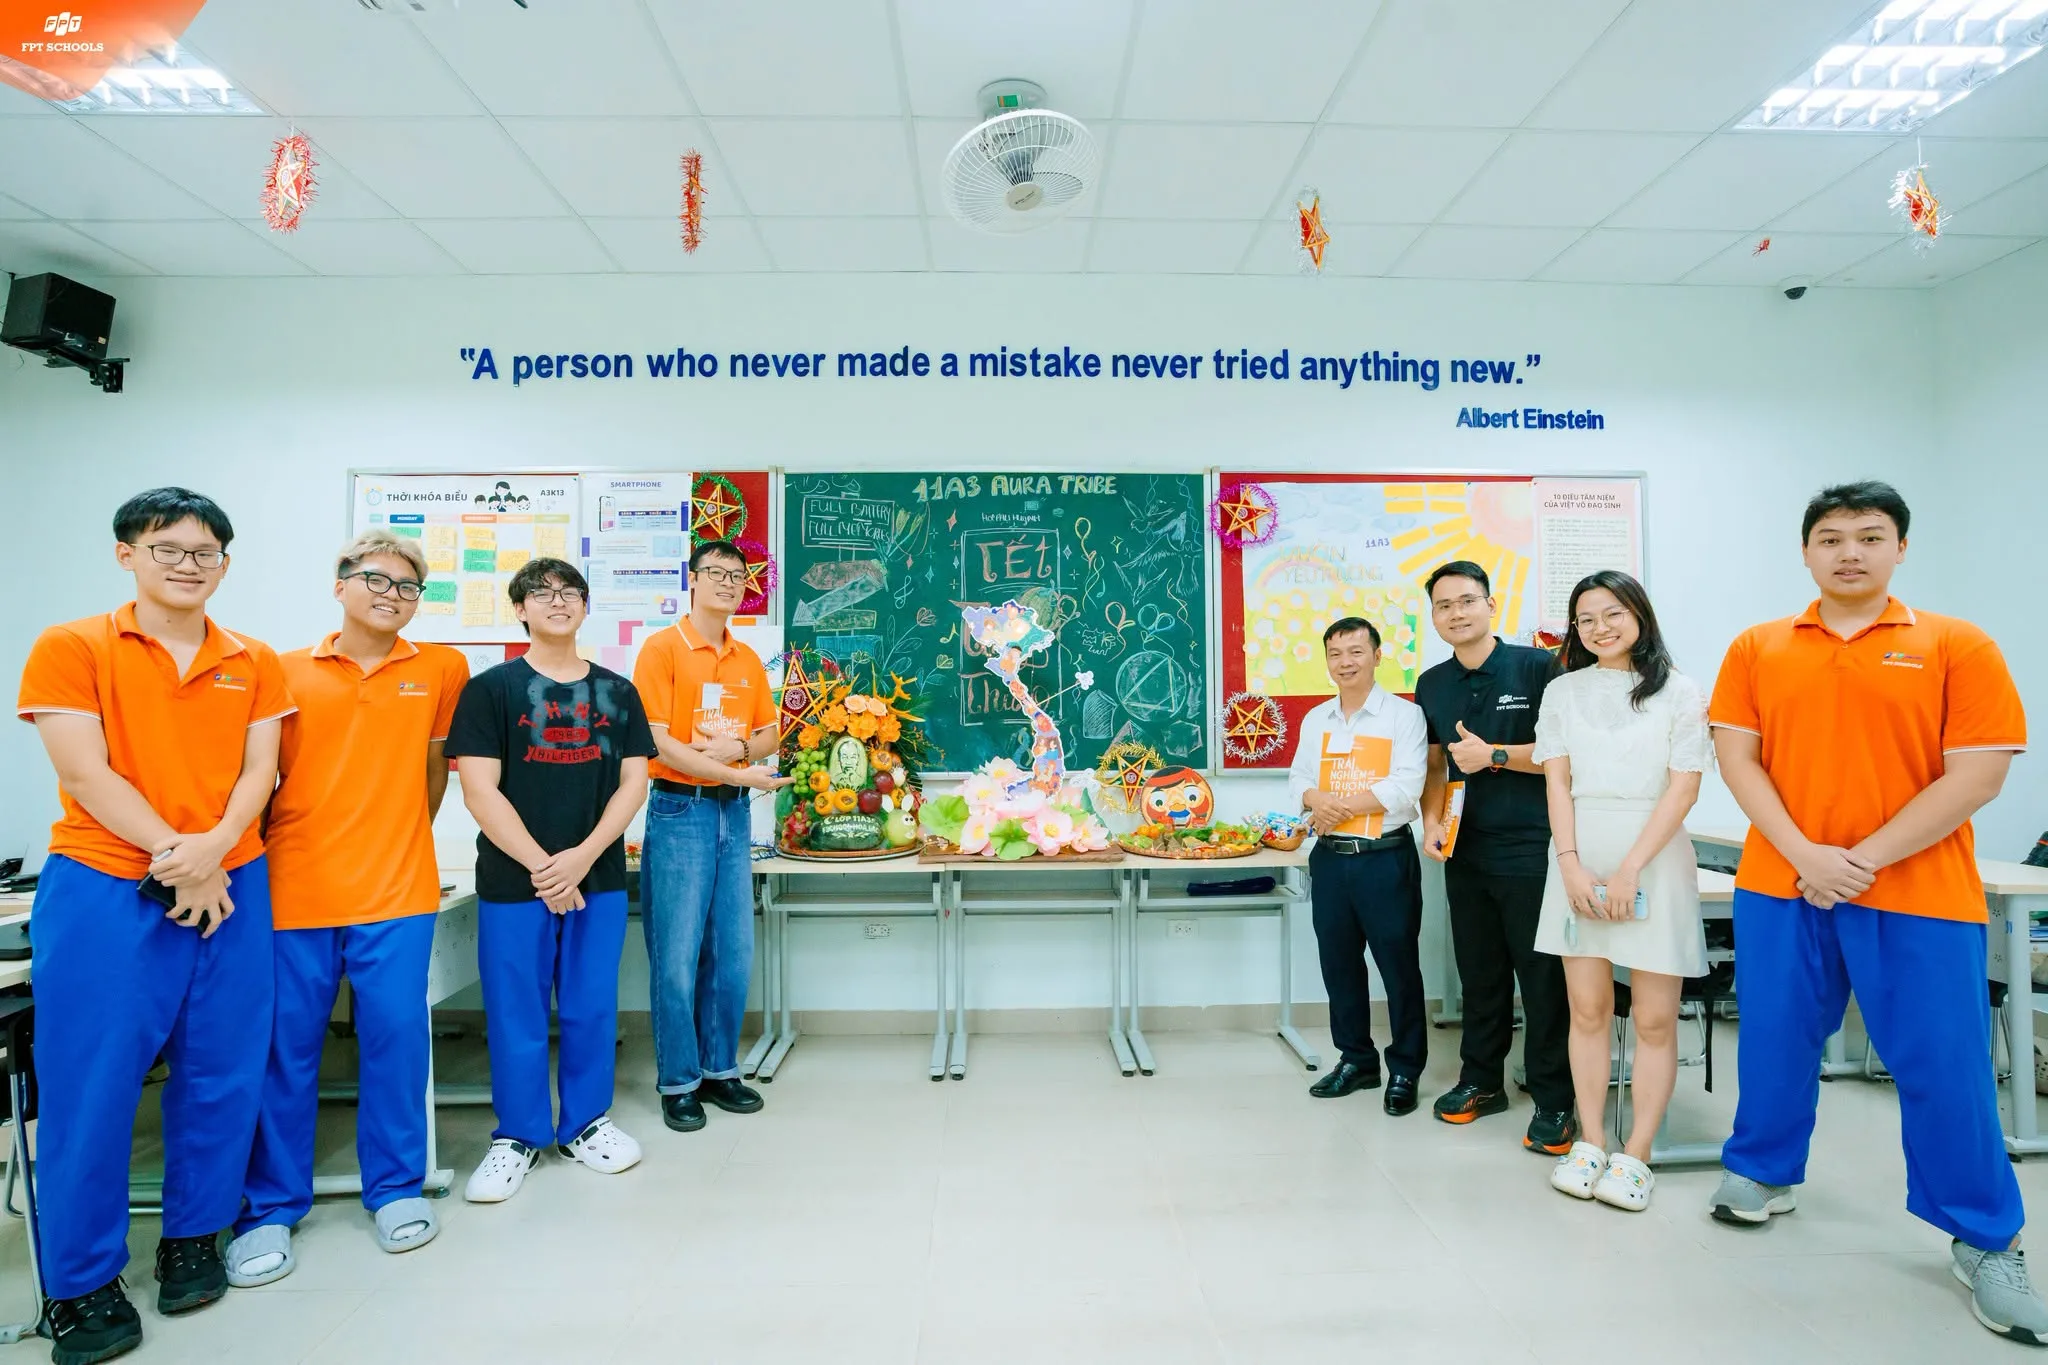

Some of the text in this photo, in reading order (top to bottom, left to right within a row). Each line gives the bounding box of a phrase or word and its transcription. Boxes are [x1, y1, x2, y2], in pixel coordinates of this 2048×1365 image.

[512, 353, 633, 388] person
[646, 347, 719, 378] who
[729, 353, 827, 378] never
[837, 345, 931, 377] made
[940, 352, 959, 377] a
[969, 345, 1102, 378] mistake
[1111, 354, 1204, 380] never
[1212, 348, 1290, 380] tried
[1299, 350, 1440, 392] anything
[1456, 407, 1605, 430] Albert Einstein
[413, 491, 442, 502] KHÓA
[540, 489, 565, 497] A3K13
[912, 474, 1118, 503] 11A3 AURA TRIBE
[810, 499, 891, 524] FULL BATTERY
[808, 520, 838, 537] FULL
[537, 748, 595, 761] HILFIGER
